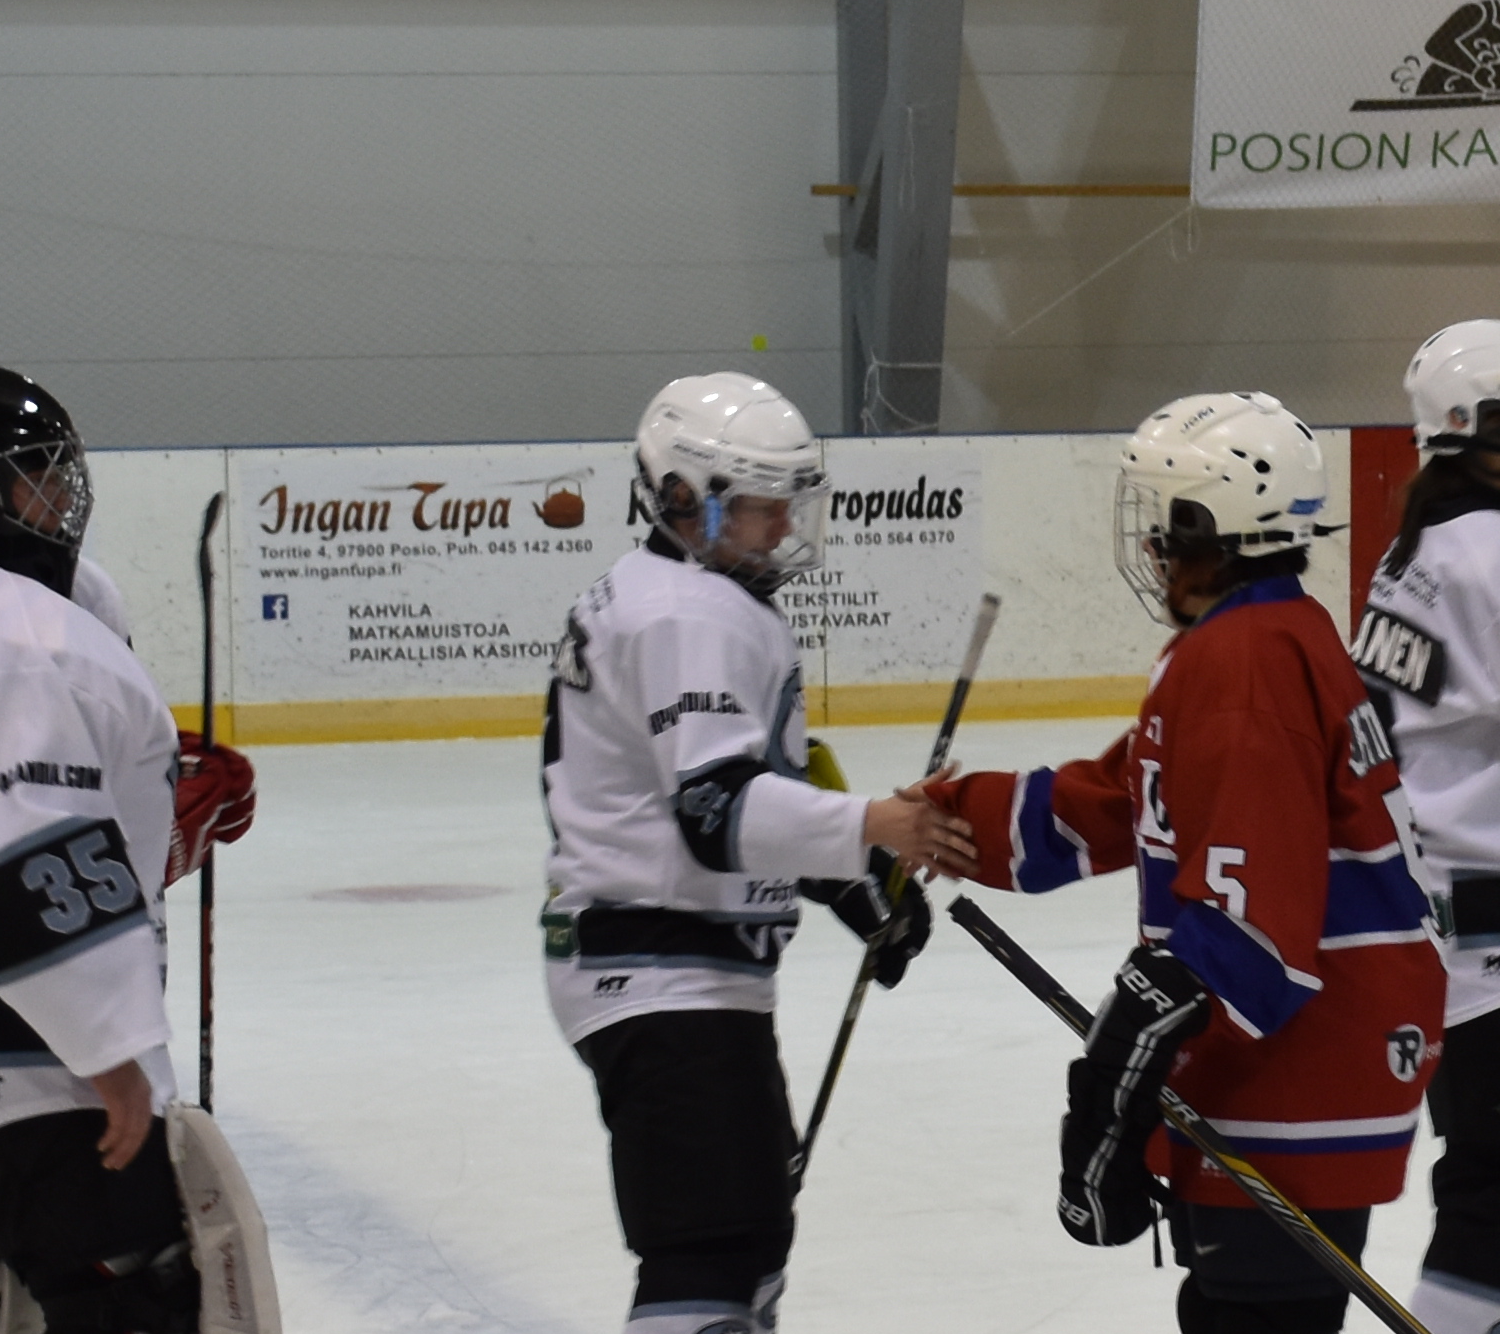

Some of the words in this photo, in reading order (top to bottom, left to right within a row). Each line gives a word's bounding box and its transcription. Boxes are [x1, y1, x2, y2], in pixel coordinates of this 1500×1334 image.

[1208, 128, 1413, 177] POSION
[259, 484, 393, 542] Ingan
[405, 481, 512, 537] Tupa
[829, 475, 964, 527] ropudas
[260, 545, 311, 561] Toritie
[336, 543, 385, 558] 97900
[488, 540, 517, 556] 045
[522, 539, 551, 554] 142
[555, 538, 594, 554] 4360
[854, 533, 883, 546] 050
[887, 532, 915, 545] 564
[919, 530, 956, 545] 6370
[348, 602, 432, 620] KAHVILA
[348, 622, 511, 641] MATKAMUISTOJA
[348, 644, 467, 663] PAIKALLISIA
[20, 830, 142, 936] 35
[1204, 846, 1248, 921] 5
